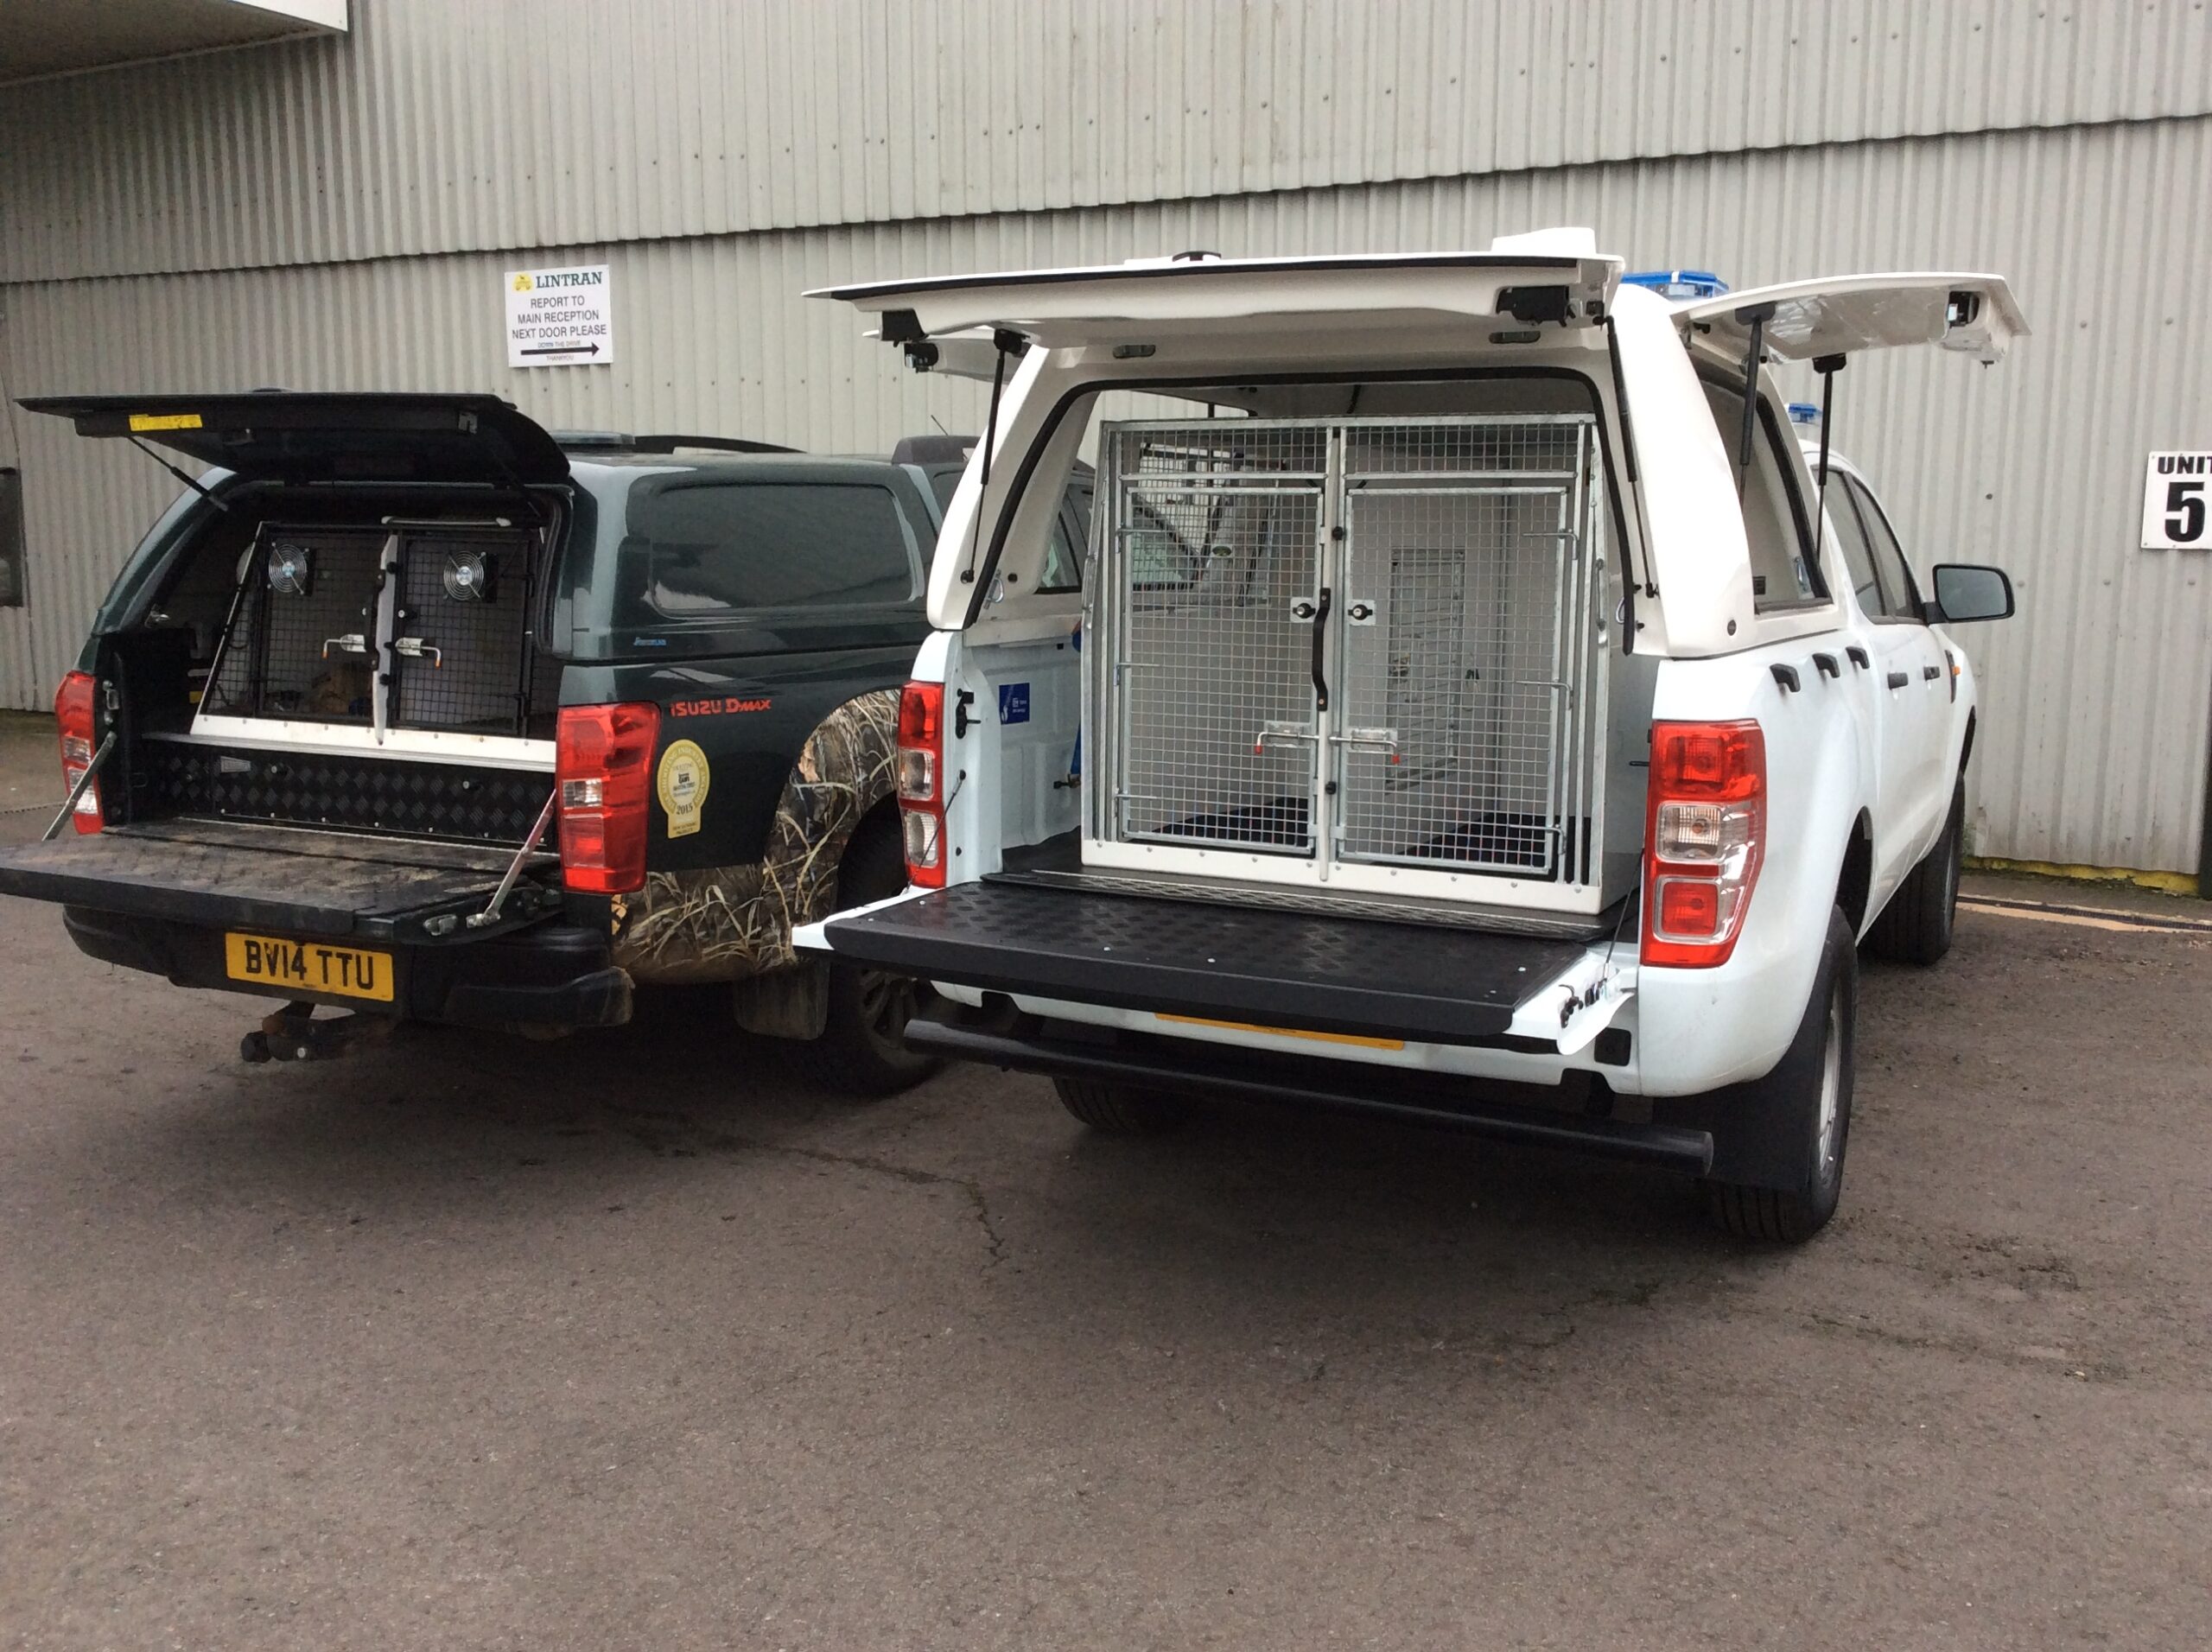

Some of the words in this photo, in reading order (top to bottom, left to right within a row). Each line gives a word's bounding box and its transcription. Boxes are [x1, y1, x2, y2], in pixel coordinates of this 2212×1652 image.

[536, 271, 602, 289] LINTRAN
[531, 295, 569, 308] REPORT
[571, 295, 586, 306] TO
[518, 313, 542, 324] MAIN
[544, 309, 600, 323] RECEPTION
[512, 328, 536, 340] NEXT
[538, 327, 567, 338] DOOR
[569, 324, 607, 336] PLEASE
[2164, 481, 2206, 543] 5
[677, 803, 694, 815] 2015
[245, 940, 307, 981] BV14
[316, 950, 373, 990] TTU
